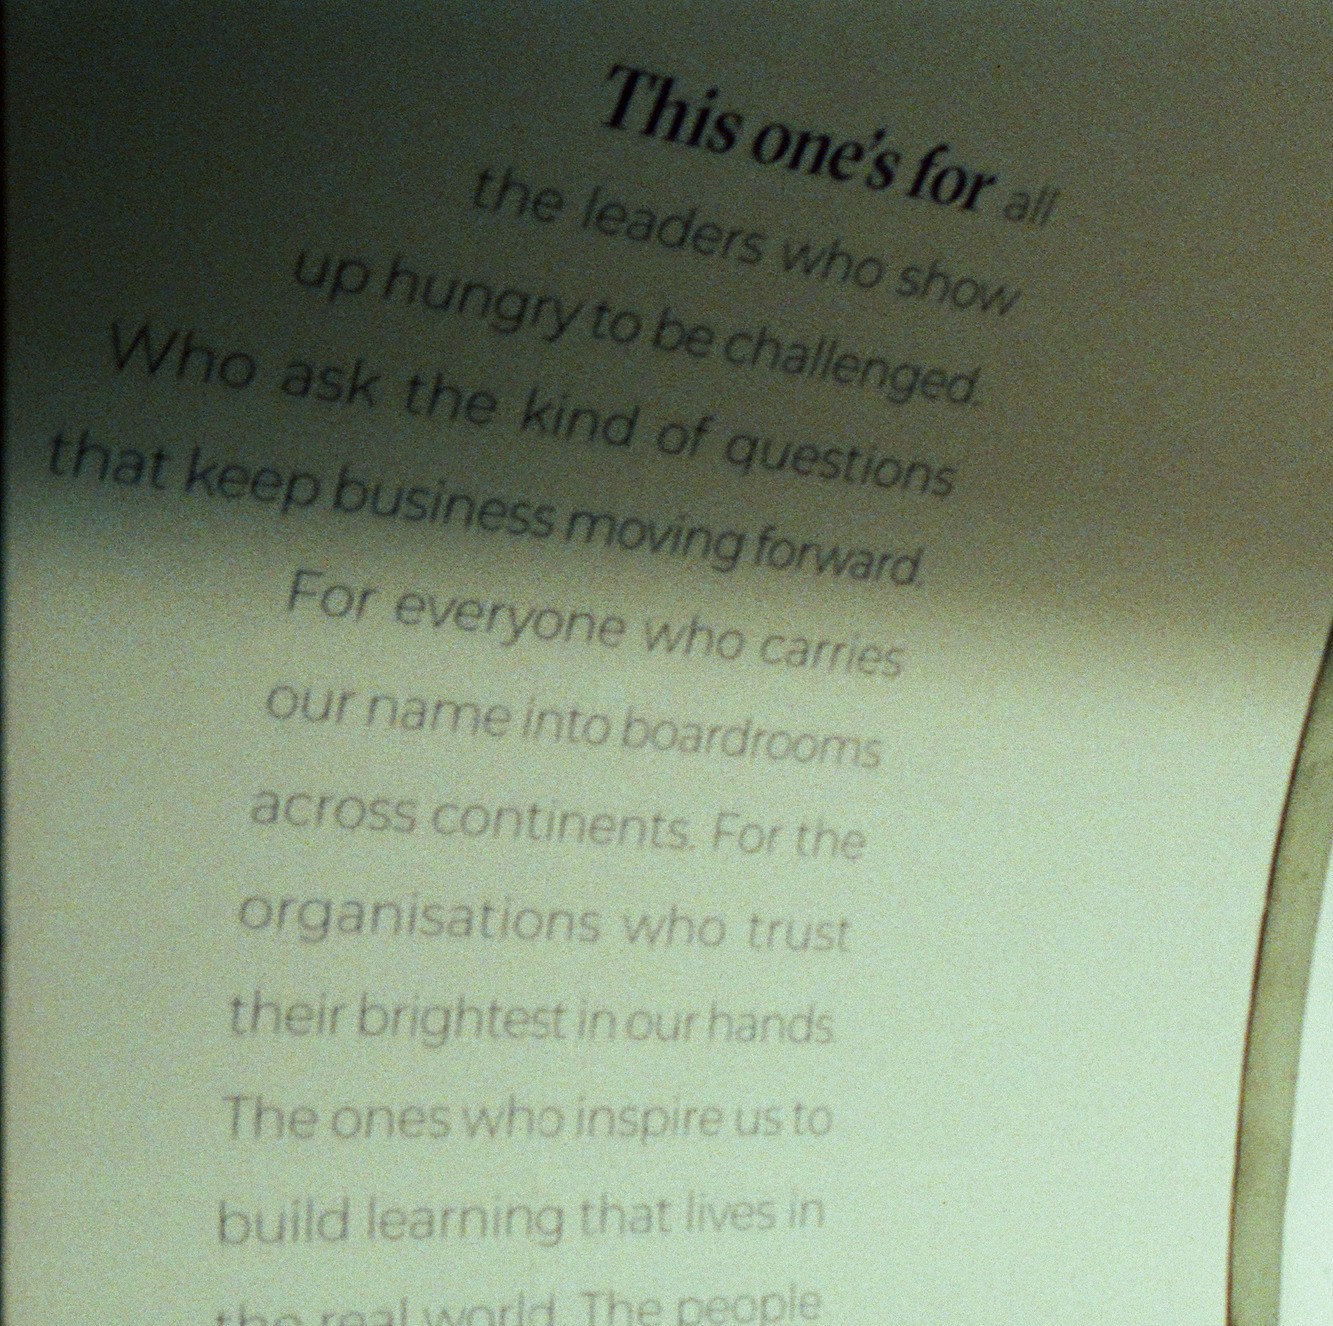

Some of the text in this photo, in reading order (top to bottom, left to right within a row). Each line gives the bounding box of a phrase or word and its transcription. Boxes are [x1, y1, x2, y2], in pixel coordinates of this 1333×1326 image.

[604, 62, 1062, 228] This one's for all
[471, 166, 1023, 318] the leaders who show
[292, 250, 982, 408] up hungry to be challenged.
[108, 319, 957, 500] Who ask the kind of questions
[49, 428, 171, 492] that
[183, 445, 322, 518] keep
[331, 462, 555, 540] business
[564, 509, 747, 575] moving
[284, 566, 904, 681] For everyone who carries
[263, 683, 882, 771] our name into boardrooms
[249, 788, 868, 862] across continents. For the
[236, 894, 851, 954] organisations who trust
[228, 988, 347, 1039] their
[356, 991, 567, 1051] brightest
[577, 998, 618, 1041] in
[624, 1008, 699, 1044] our
[222, 1092, 834, 1150] The ones who inspire us to
[216, 1186, 825, 1249] build learning that lives in
